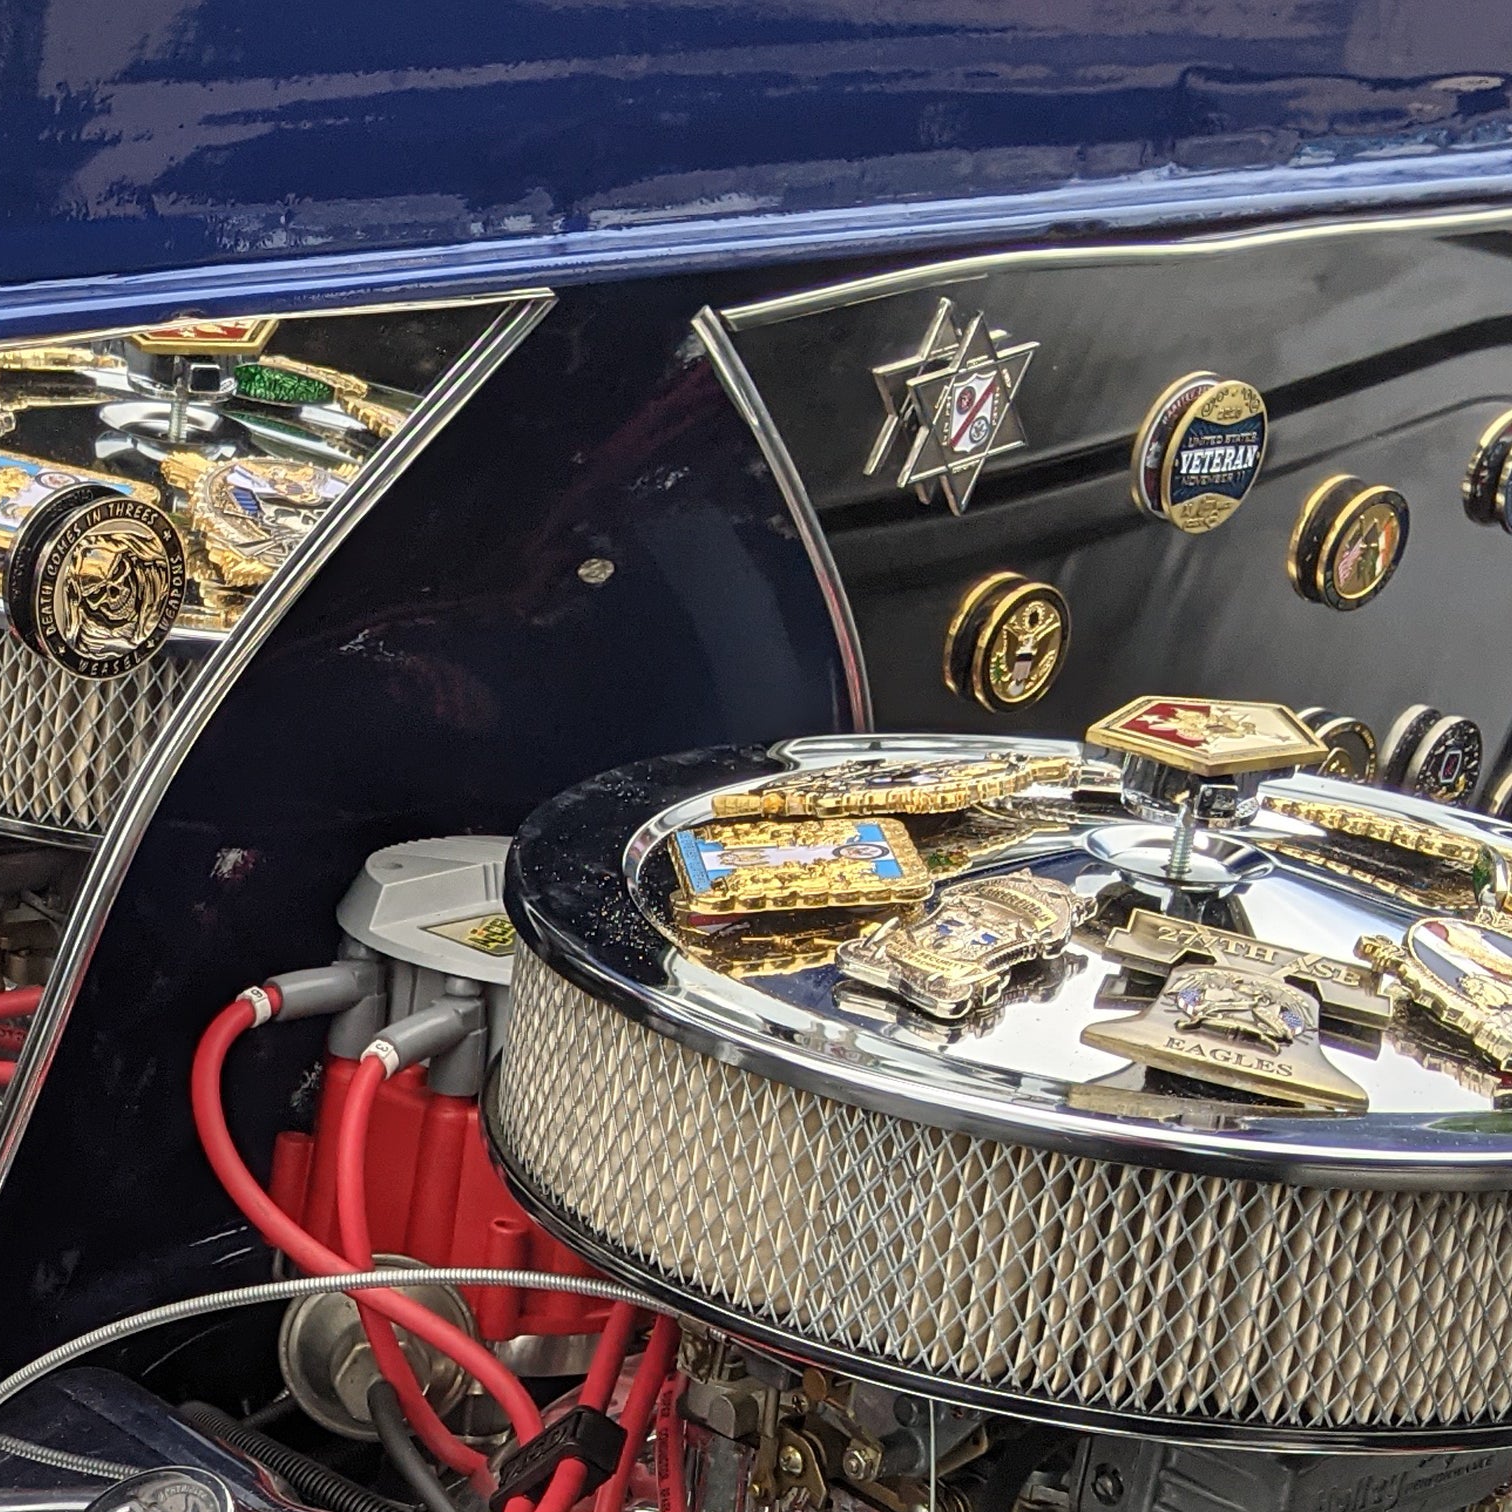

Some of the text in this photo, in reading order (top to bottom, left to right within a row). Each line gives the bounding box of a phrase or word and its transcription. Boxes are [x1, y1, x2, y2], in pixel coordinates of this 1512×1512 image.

[1180, 445, 1259, 474] VETERAN
[41, 503, 160, 635] DEATH COMES IN THREES
[158, 553, 184, 632] WEAPONS
[78, 653, 143, 676] WEASEL
[1163, 1036, 1293, 1078] EAGLES
